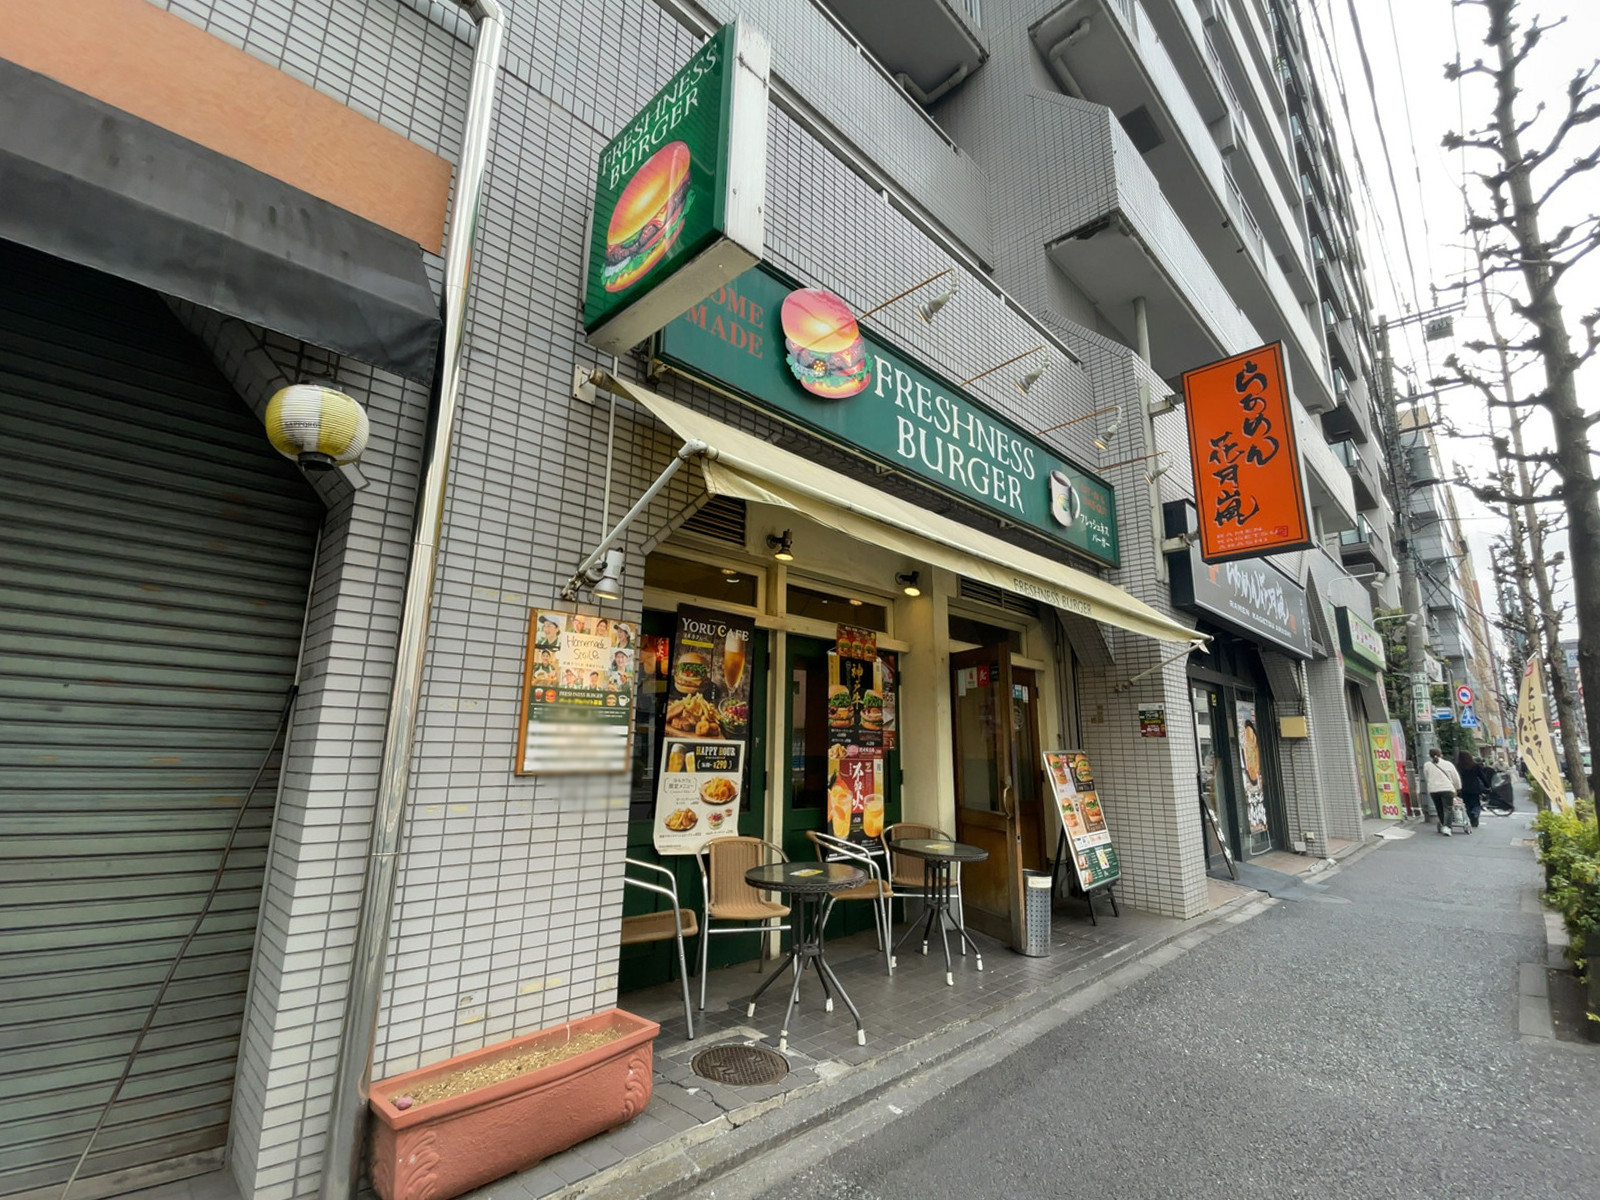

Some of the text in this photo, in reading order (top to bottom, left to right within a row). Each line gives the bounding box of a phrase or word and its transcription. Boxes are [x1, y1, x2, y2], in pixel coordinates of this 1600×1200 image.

[601, 42, 718, 177] FRESHNESS
[608, 87, 699, 191] BURGER
[686, 304, 764, 359] MADE
[710, 285, 764, 329] OME
[873, 355, 1036, 480] FRESHNESS
[896, 415, 1025, 514] BURGER
[1208, 431, 1259, 527] 花月嵐
[681, 617, 716, 636] YORU
[717, 624, 750, 642] CAFE
[1013, 577, 1092, 615] FRESHNESS BURGER
[1229, 599, 1251, 617] RAMEN
